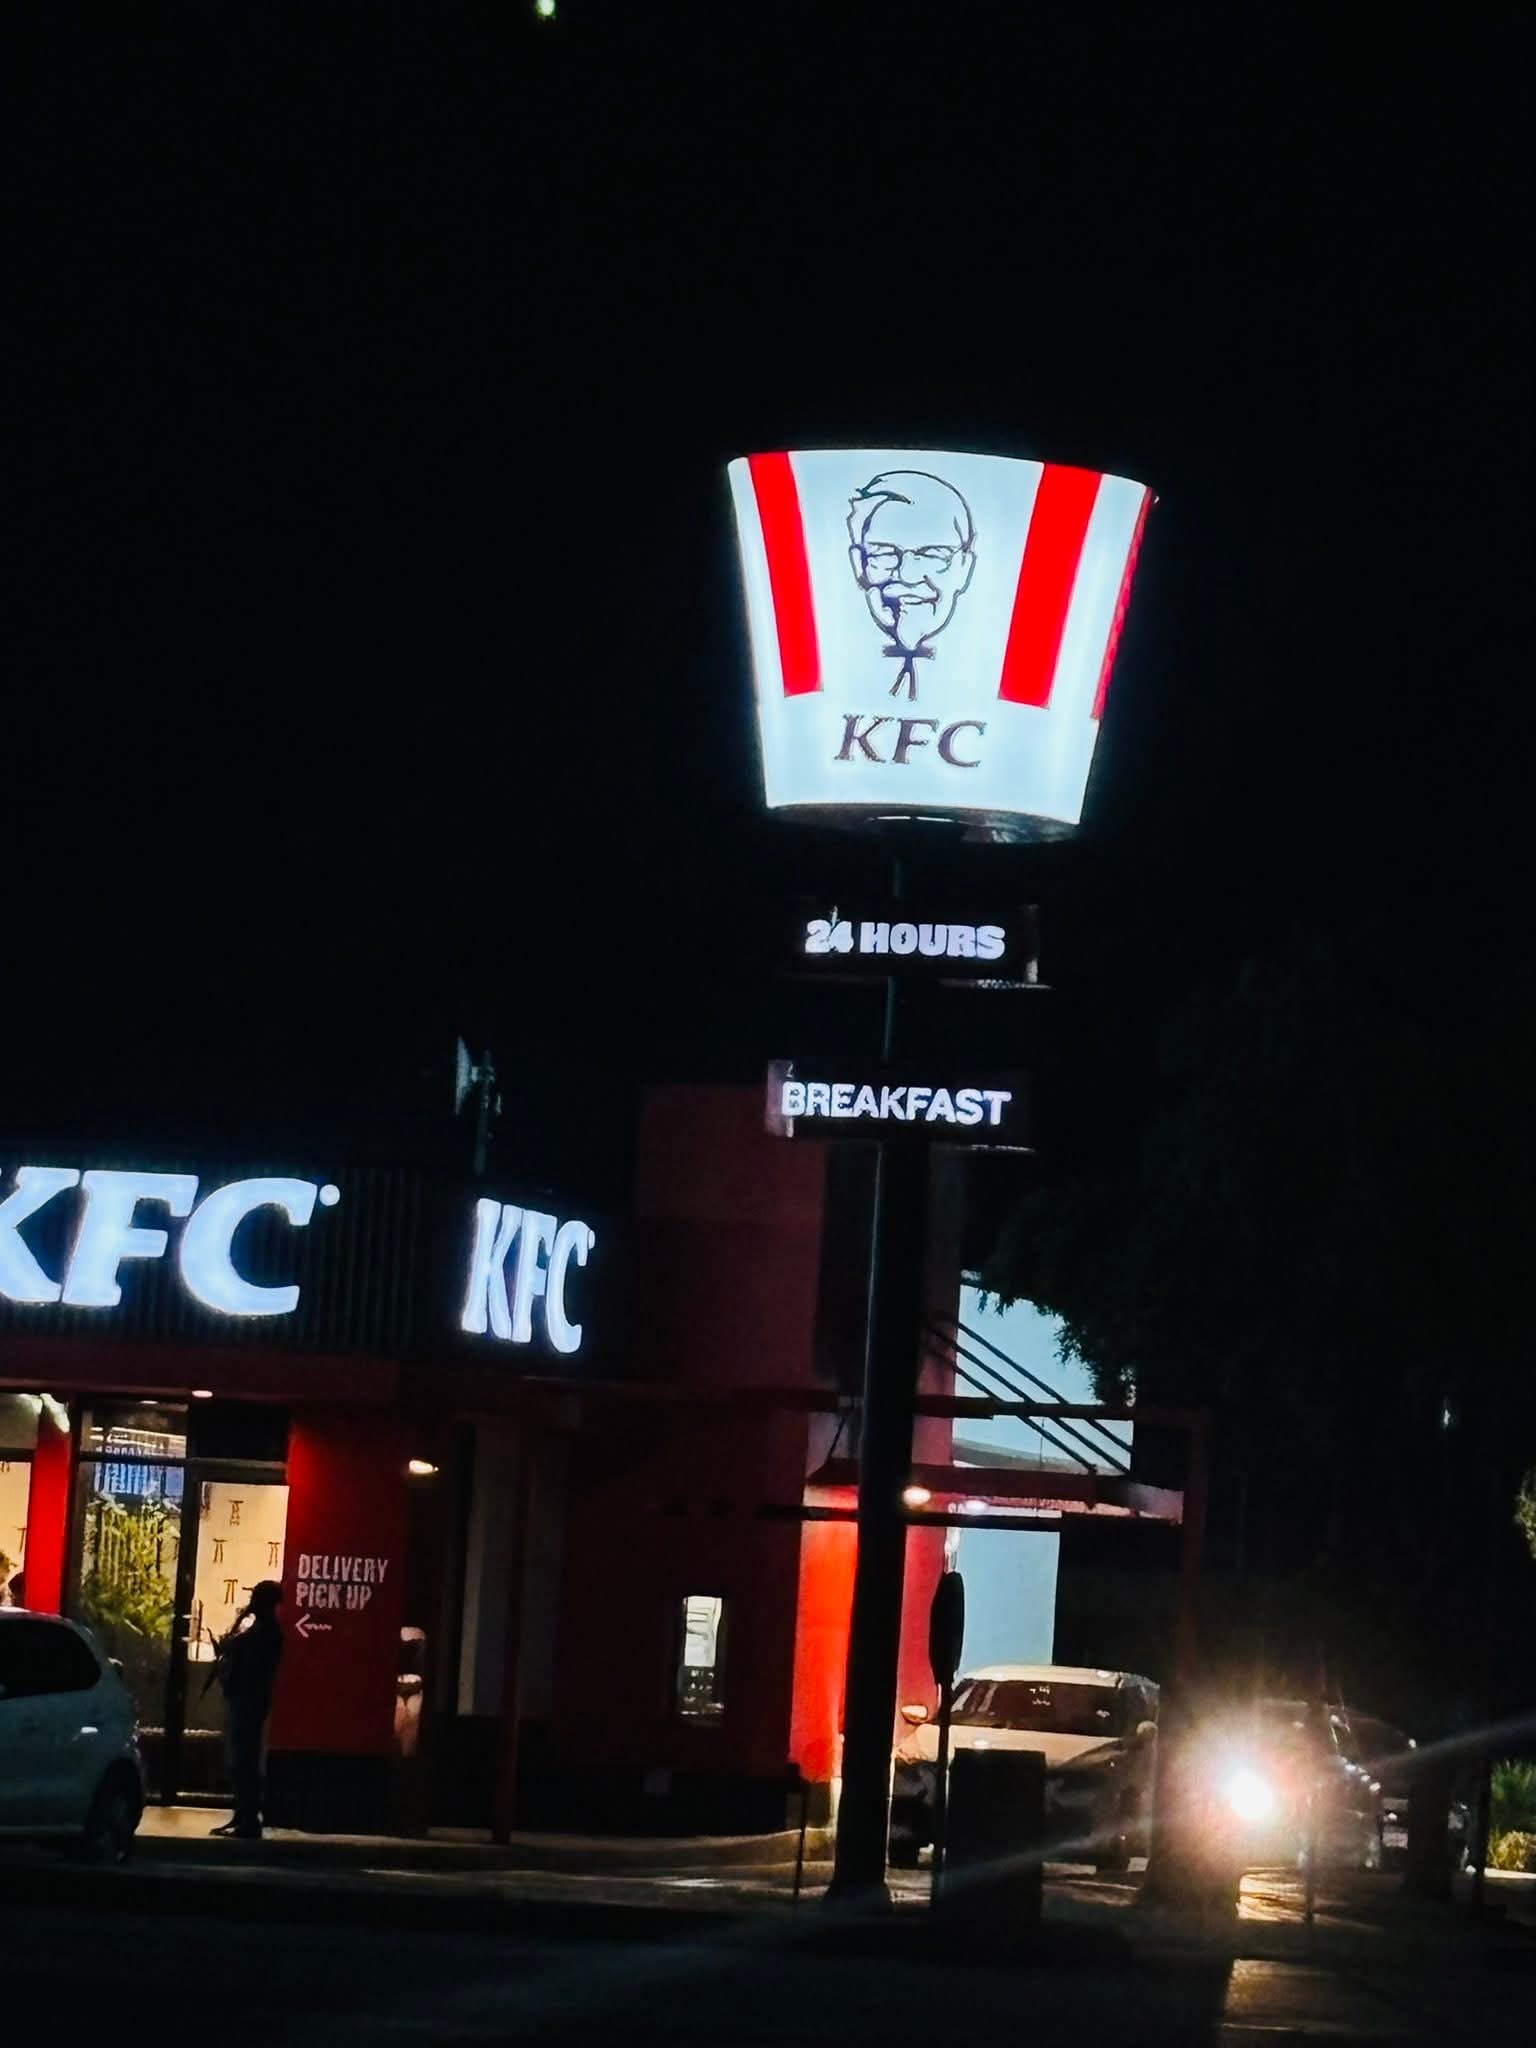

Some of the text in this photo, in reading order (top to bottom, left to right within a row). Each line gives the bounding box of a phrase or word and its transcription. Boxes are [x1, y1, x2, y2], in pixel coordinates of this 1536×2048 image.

[834, 714, 987, 768] KFC
[804, 918, 1006, 960] 24 HOURS
[781, 1081, 1012, 1126] BREAKFAST
[461, 1198, 591, 1354] KFC
[296, 1581, 373, 1610] PICK UP
